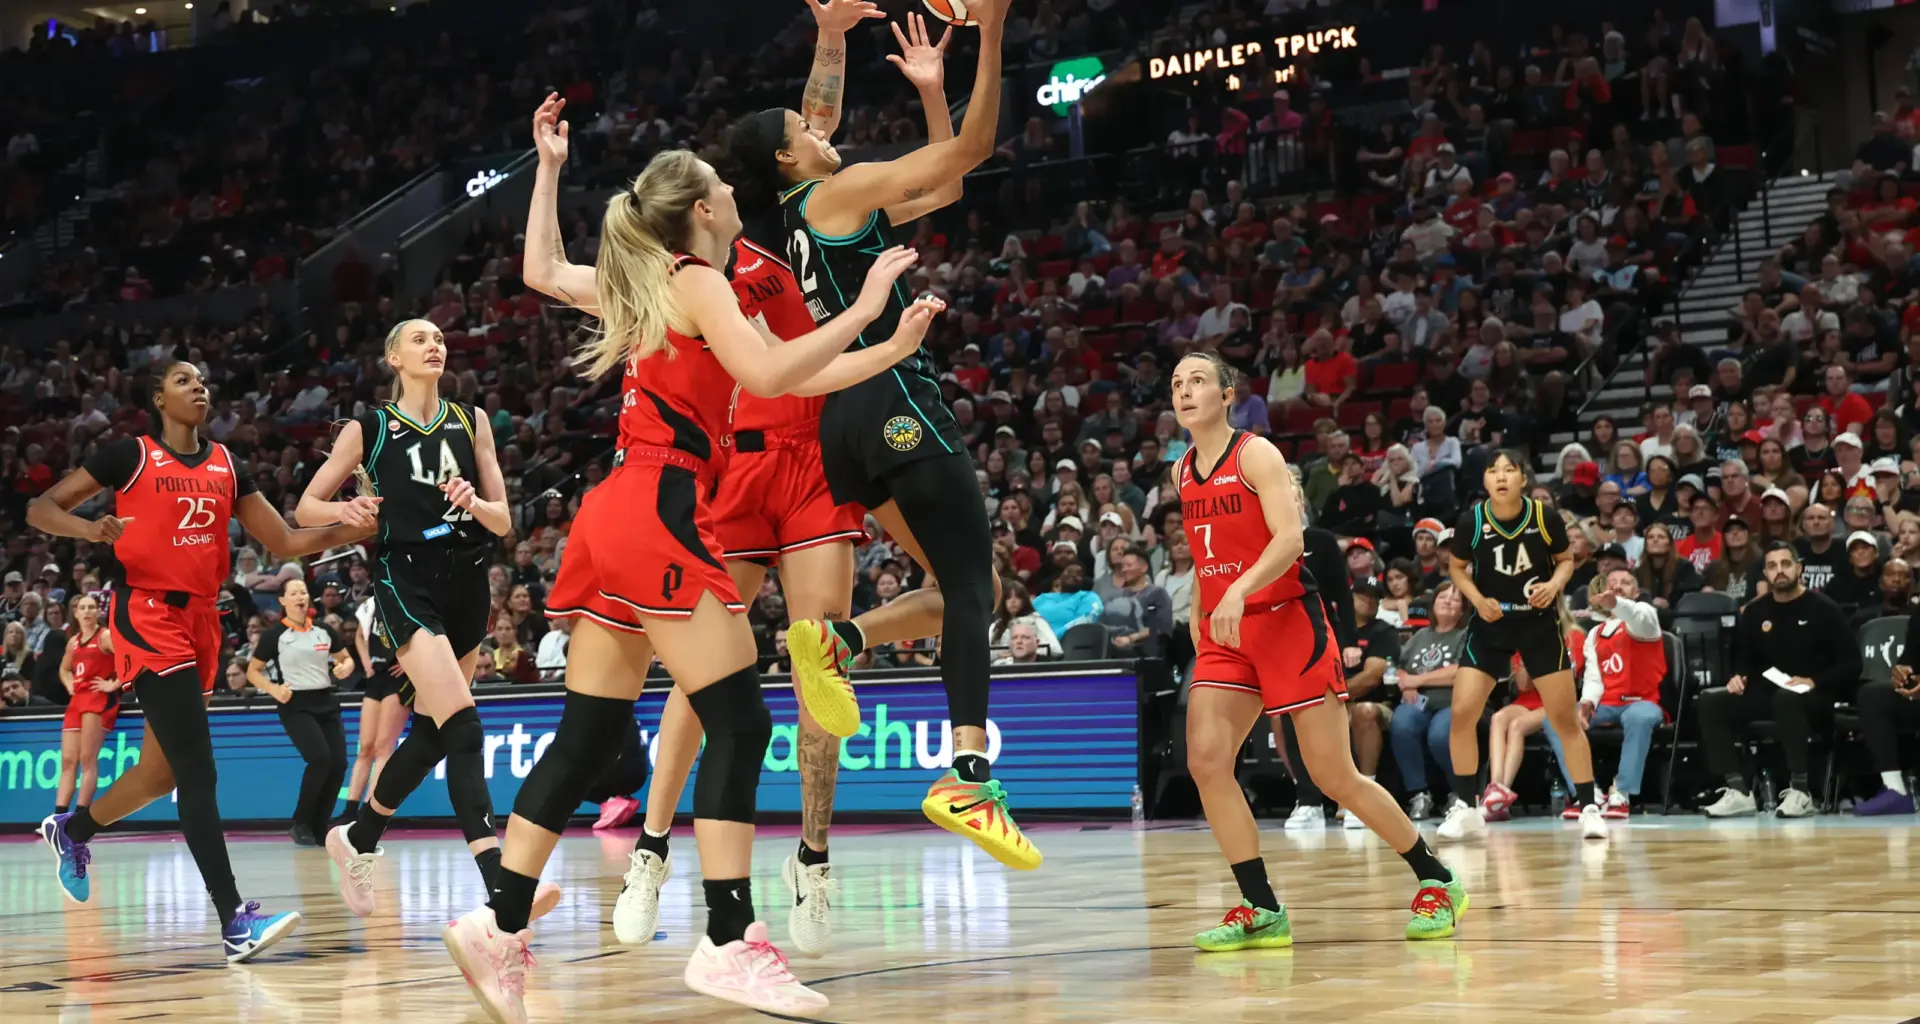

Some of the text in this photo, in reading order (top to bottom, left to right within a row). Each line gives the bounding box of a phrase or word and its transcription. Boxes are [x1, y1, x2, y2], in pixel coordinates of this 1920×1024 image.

[786, 228, 818, 294] 2
[405, 437, 461, 488] LA
[1213, 474, 1238, 486] chime
[176, 496, 217, 531] 25
[1181, 493, 1242, 520] ORTLAND
[426, 526, 448, 538] UCLA
[1193, 523, 1216, 560] 7
[1492, 542, 1533, 576] LA
